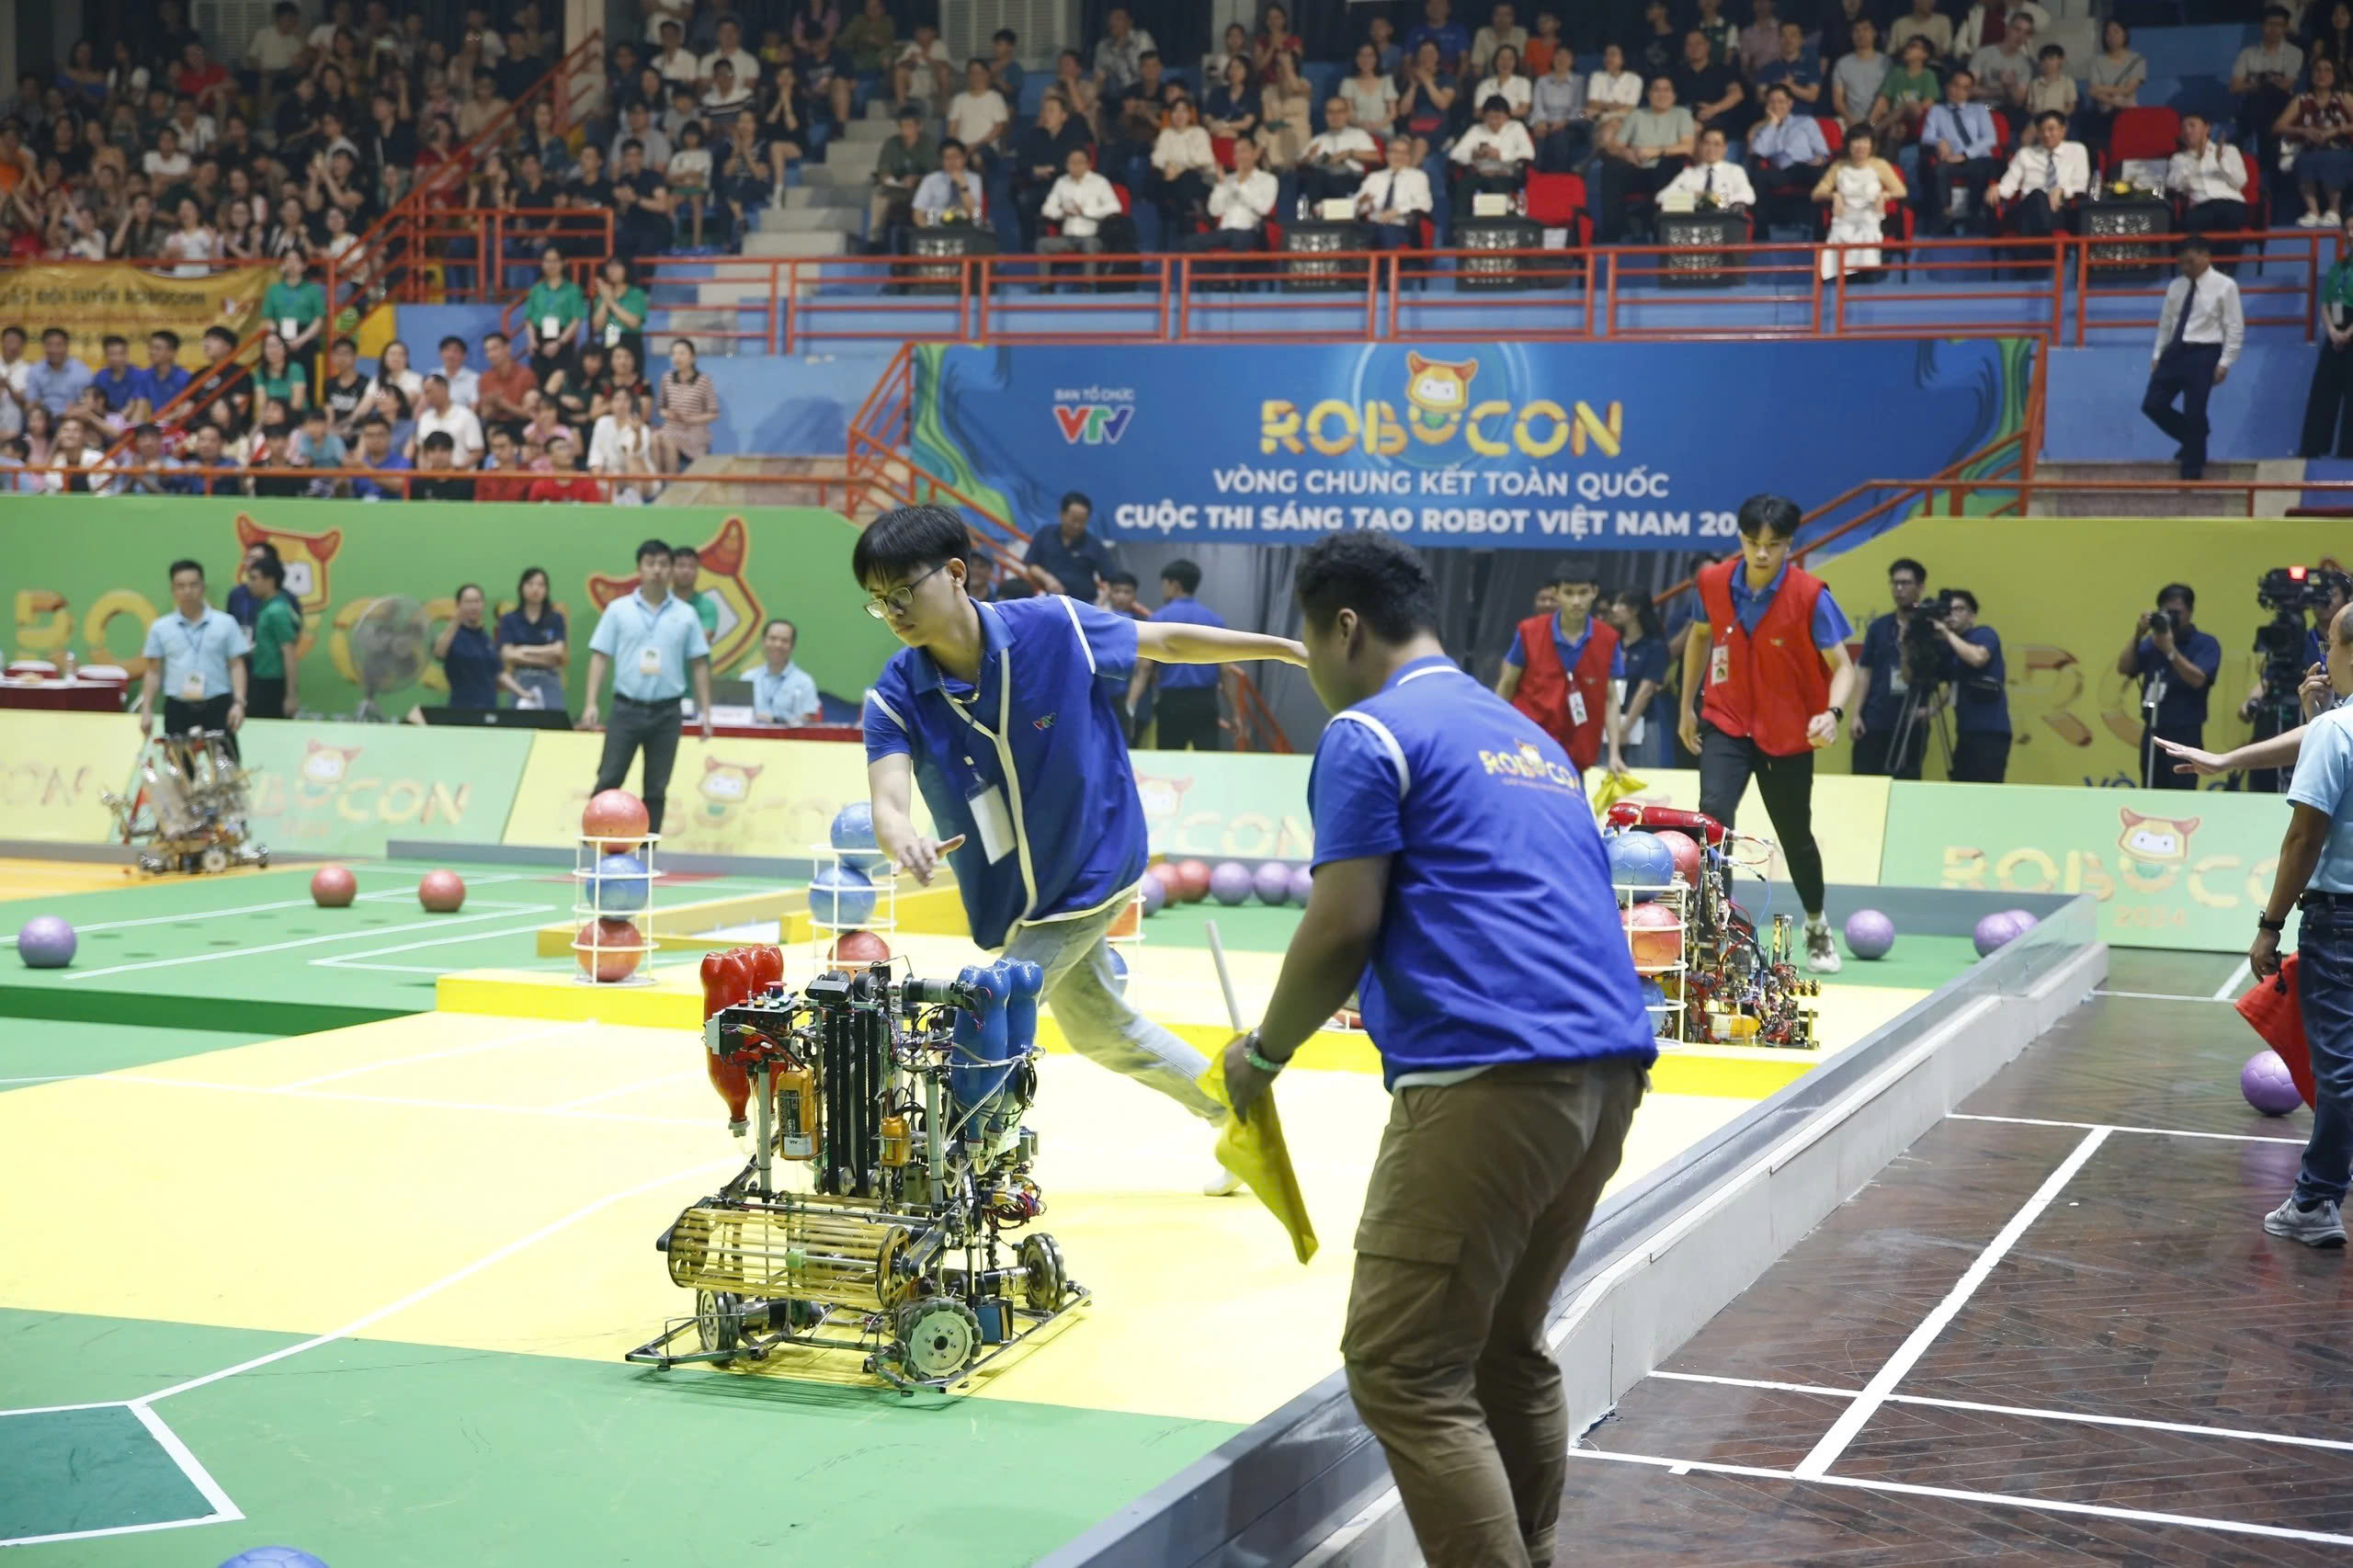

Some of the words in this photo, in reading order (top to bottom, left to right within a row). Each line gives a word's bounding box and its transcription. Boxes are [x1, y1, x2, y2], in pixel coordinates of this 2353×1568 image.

[1054, 388, 1080, 402] BAN
[1052, 404, 1136, 446] VTV
[1213, 463, 1297, 494] VÒNG
[1304, 469, 1412, 494] CHUNG
[1421, 463, 1477, 496] KẾT
[1483, 466, 1568, 497] TOÀN
[1576, 465, 1669, 501] QUỐC
[1115, 498, 1198, 536] CUỘC
[1204, 505, 1254, 530] THI
[1260, 500, 1344, 530] SÁNG
[1421, 509, 1530, 534] ROBOT
[1536, 504, 1608, 541] VIỆT
[1616, 511, 1691, 536] NAM
[1698, 512, 1741, 536] 20
